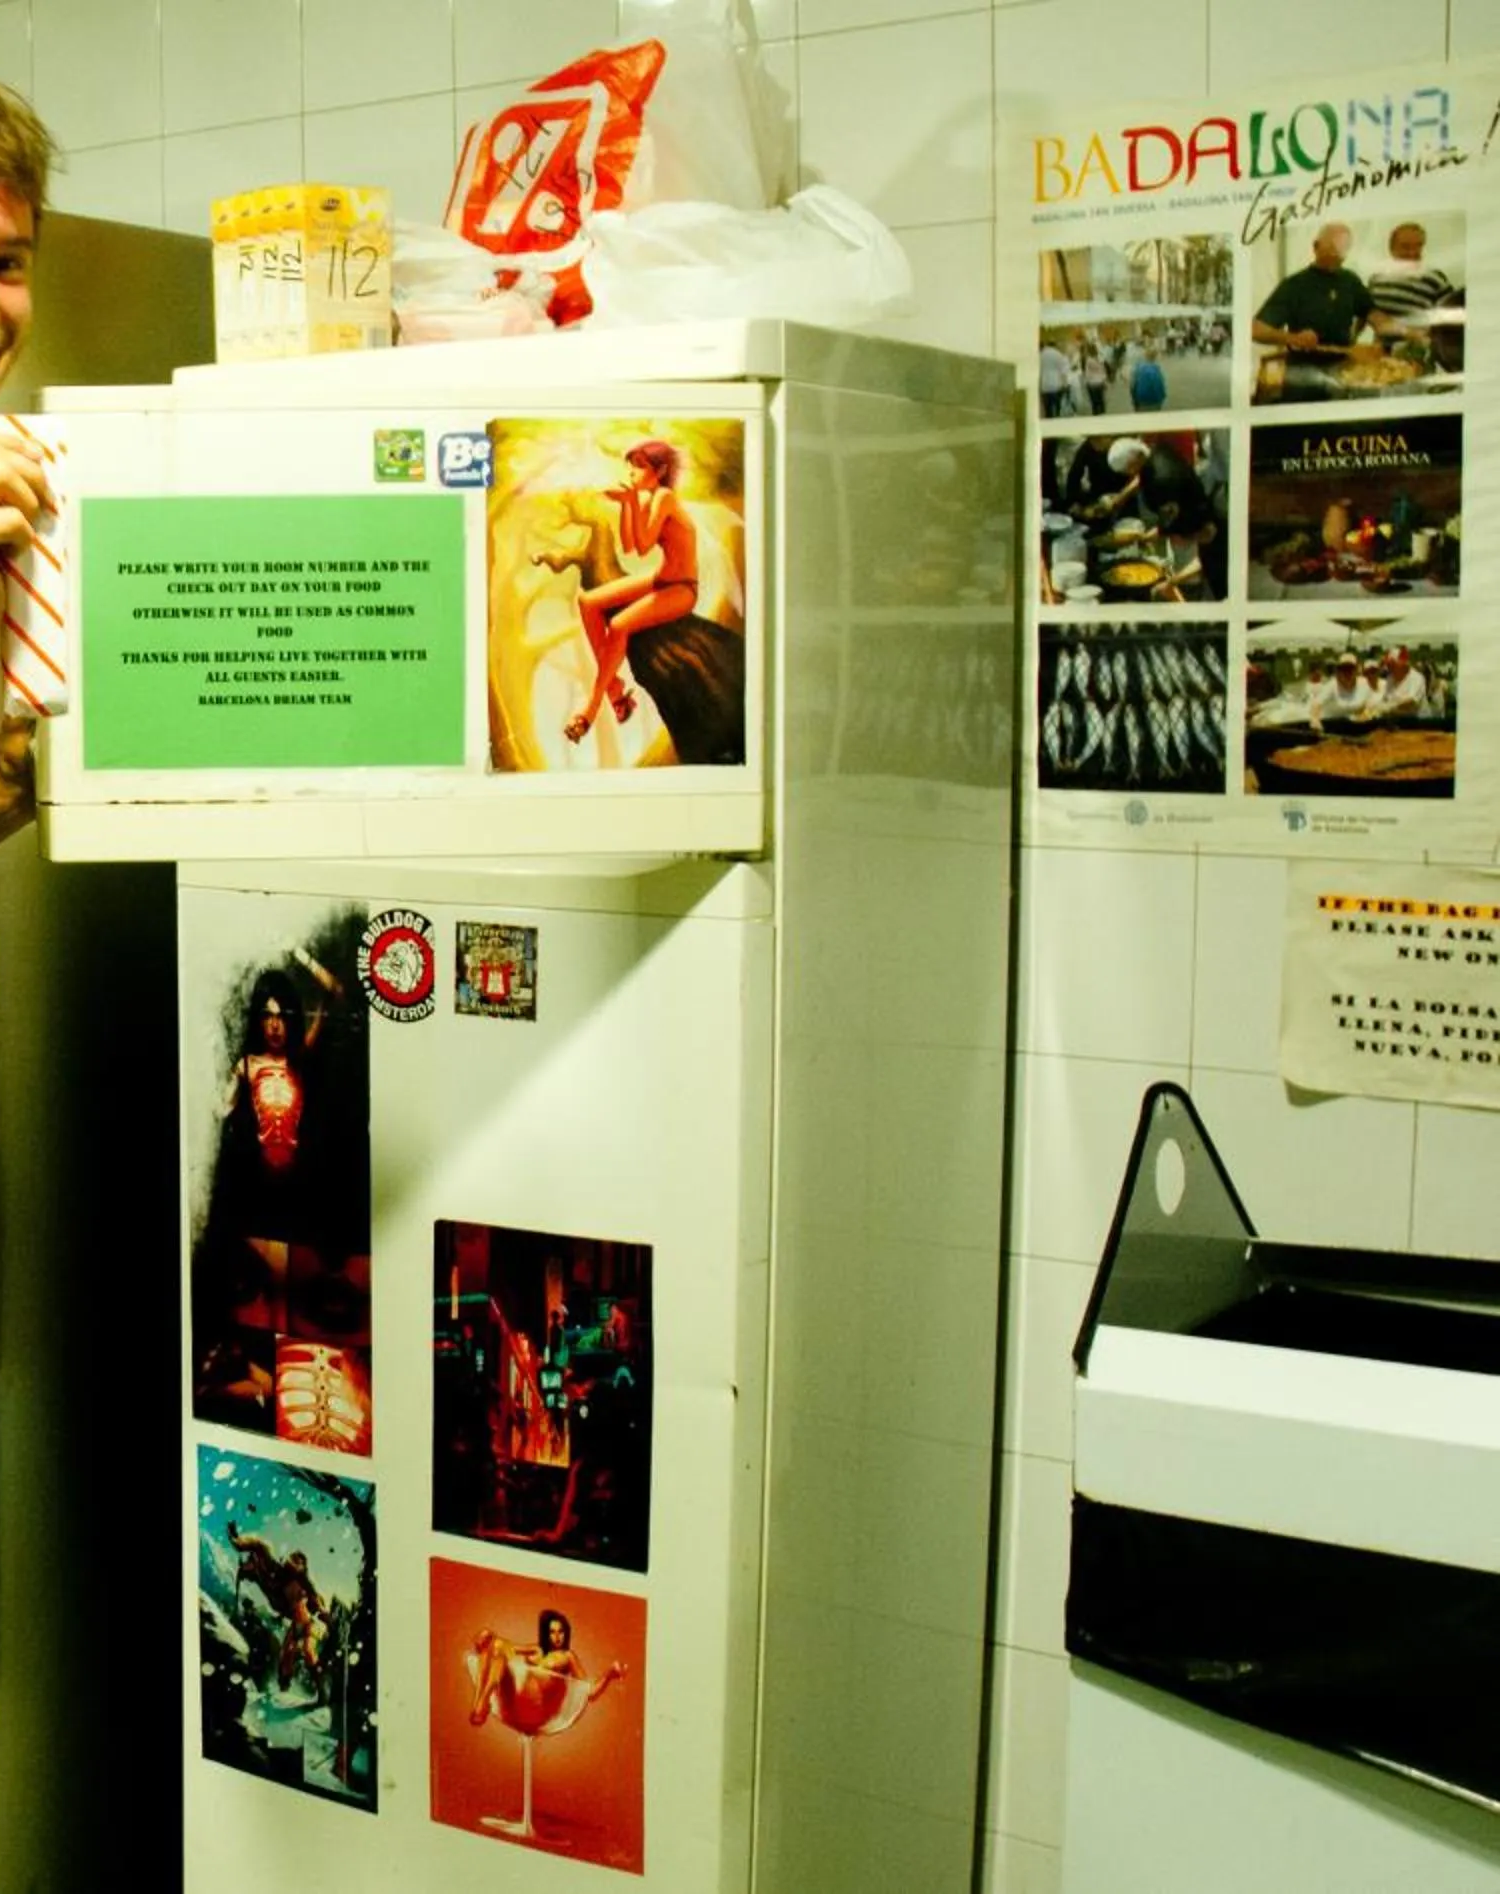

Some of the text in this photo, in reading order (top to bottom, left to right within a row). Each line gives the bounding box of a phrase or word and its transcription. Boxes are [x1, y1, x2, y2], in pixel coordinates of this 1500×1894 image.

[1033, 87, 1452, 204] BADALONA
[263, 243, 279, 280] 112
[281, 239, 304, 282] 112
[328, 238, 379, 301] 112
[1302, 433, 1409, 456] LA CUINA
[1281, 458, 1302, 472] EN
[1365, 452, 1432, 468] ROMANA
[118, 561, 430, 575] PLEASE WRITE YOUR ROOM NUMBER AND THE
[167, 581, 381, 594] CHECK OUT DAY ON YOUR FOOD
[133, 606, 415, 619] OTHERWISE IT WILL BE USED AS COMMON
[257, 626, 293, 638] FOOD
[122, 650, 427, 663] THANKS FOR HELPING LIVE TOGETHER WITH
[205, 671, 345, 683] ALL GUESTS EASIER.
[198, 694, 352, 706] BARCELONA DREAM TEAM
[1318, 896, 1344, 909] IF
[1358, 899, 1414, 914] THE
[1427, 903, 1479, 918] BAG
[1331, 920, 1495, 943] PLEASE ASK
[356, 911, 425, 981] THE BULLDOG
[1397, 947, 1454, 962] NEW
[1331, 994, 1499, 1019] SI LA BOLSA
[1460, 1050, 1500, 1067] PO
